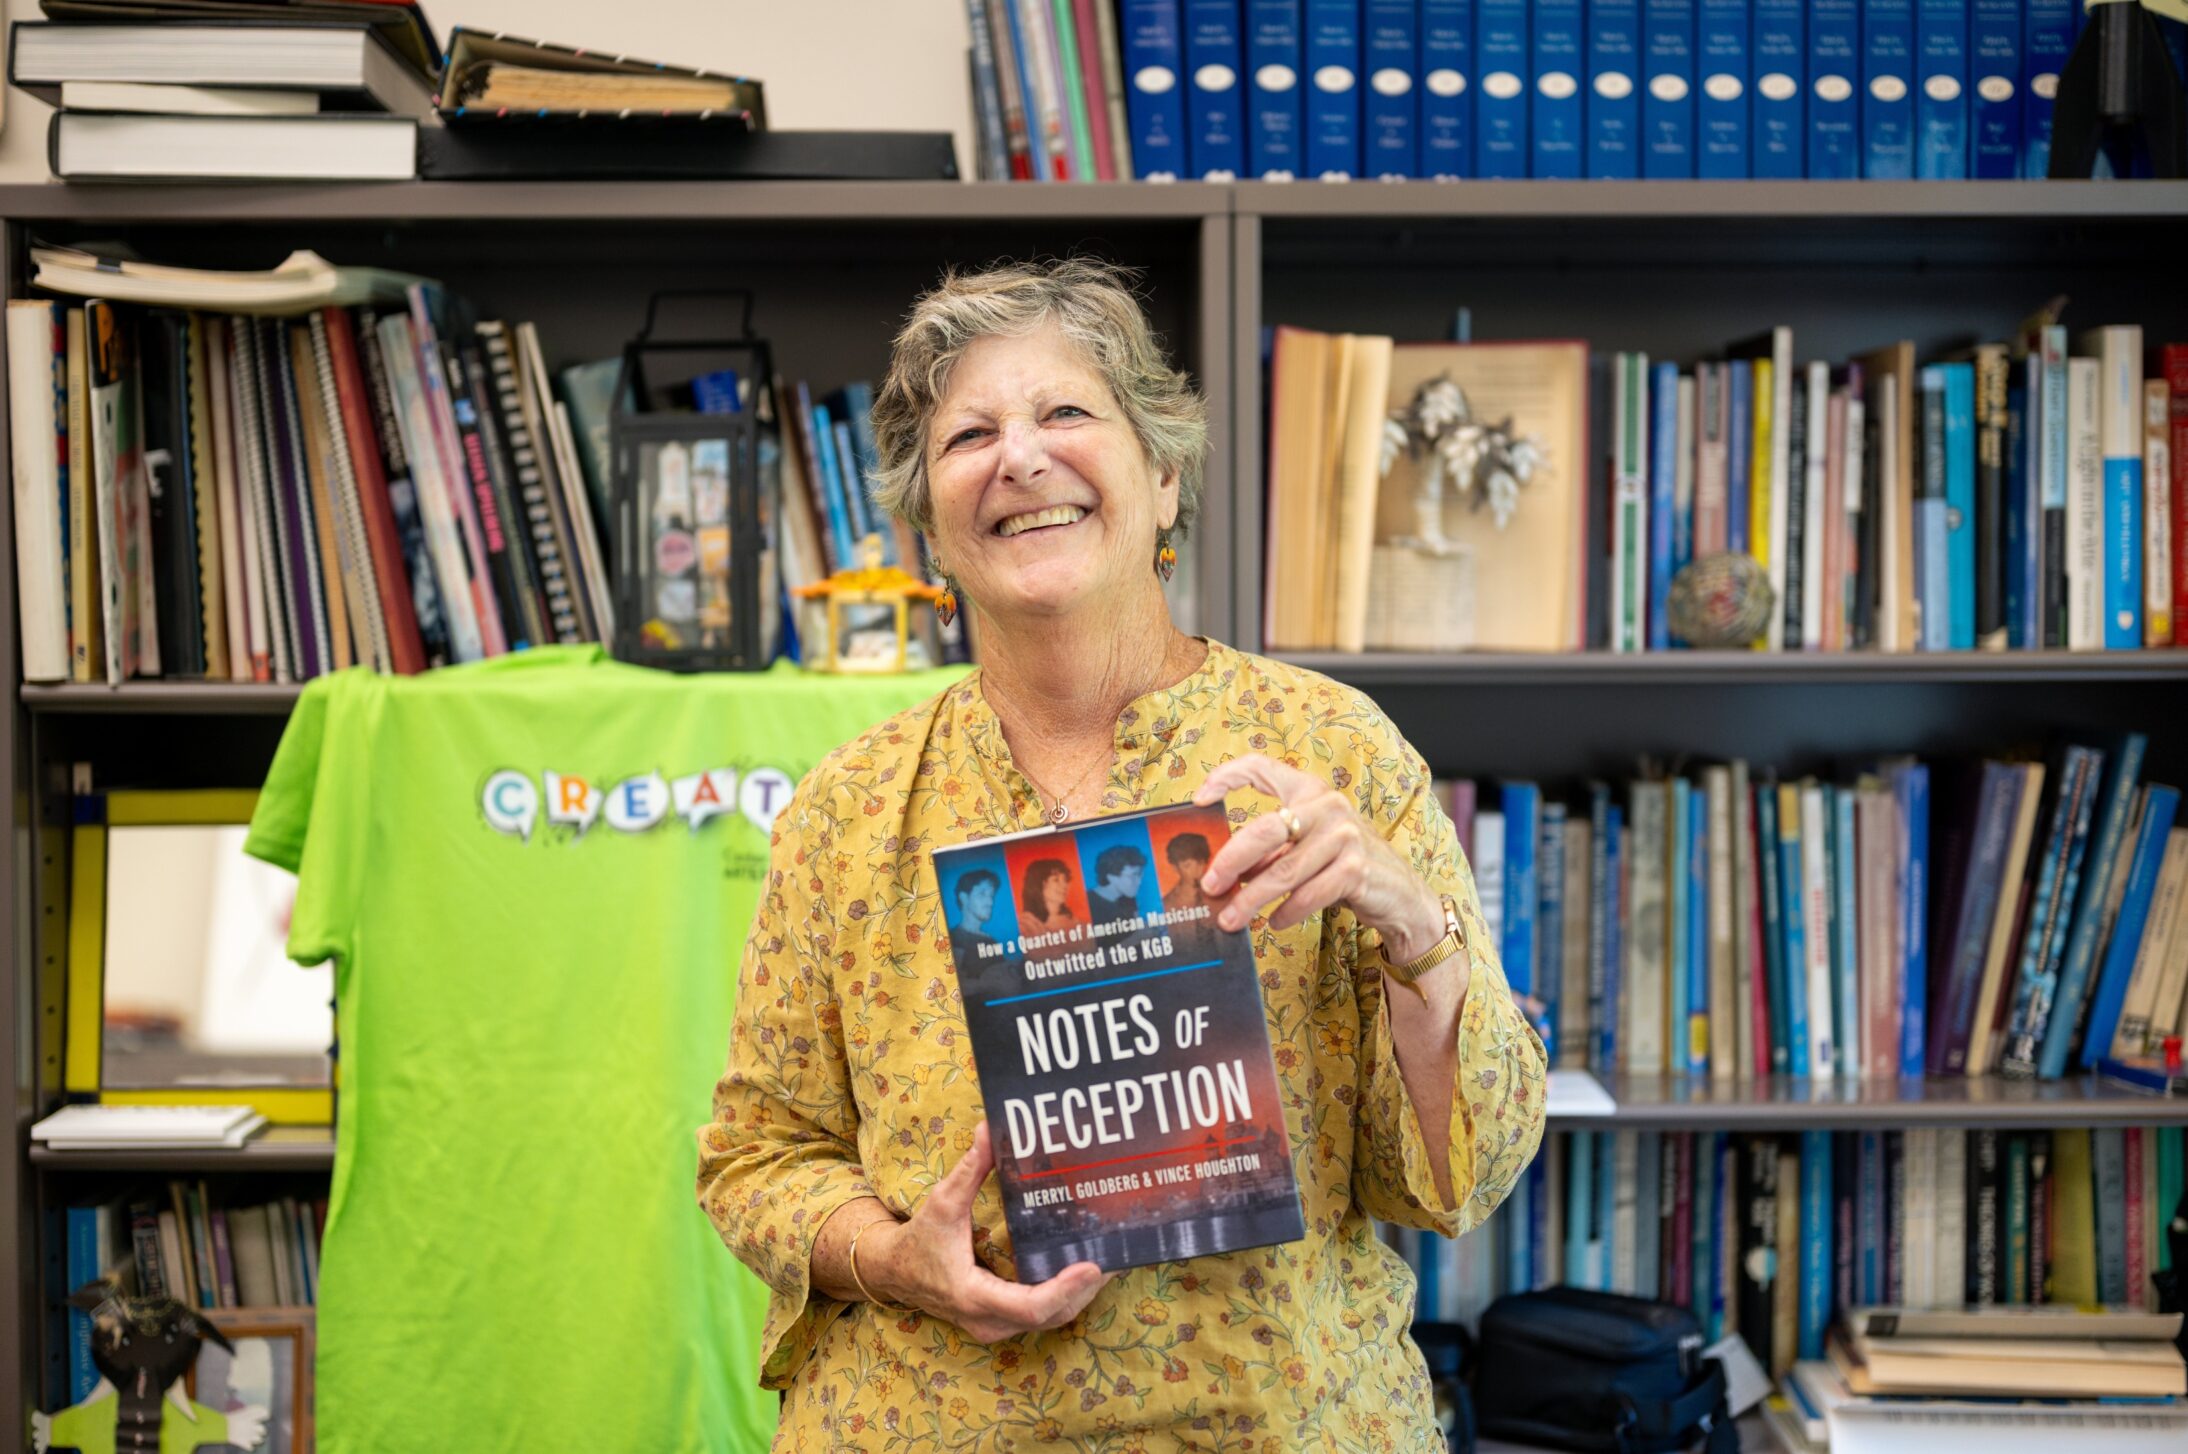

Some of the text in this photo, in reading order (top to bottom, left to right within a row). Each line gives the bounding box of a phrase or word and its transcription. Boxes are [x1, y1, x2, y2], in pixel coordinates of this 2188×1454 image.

[493, 771, 782, 819] CREAT
[977, 903, 1211, 959] How a Quartet of American Musicians
[1024, 935, 1174, 981] Outwitted the KGB
[1016, 994, 1210, 1076] NOTES OF
[1004, 1059, 1253, 1160] DECEPTION
[1023, 1153, 1261, 1209] MERRYL GOLDBERG & VINCE HOUGHTON
